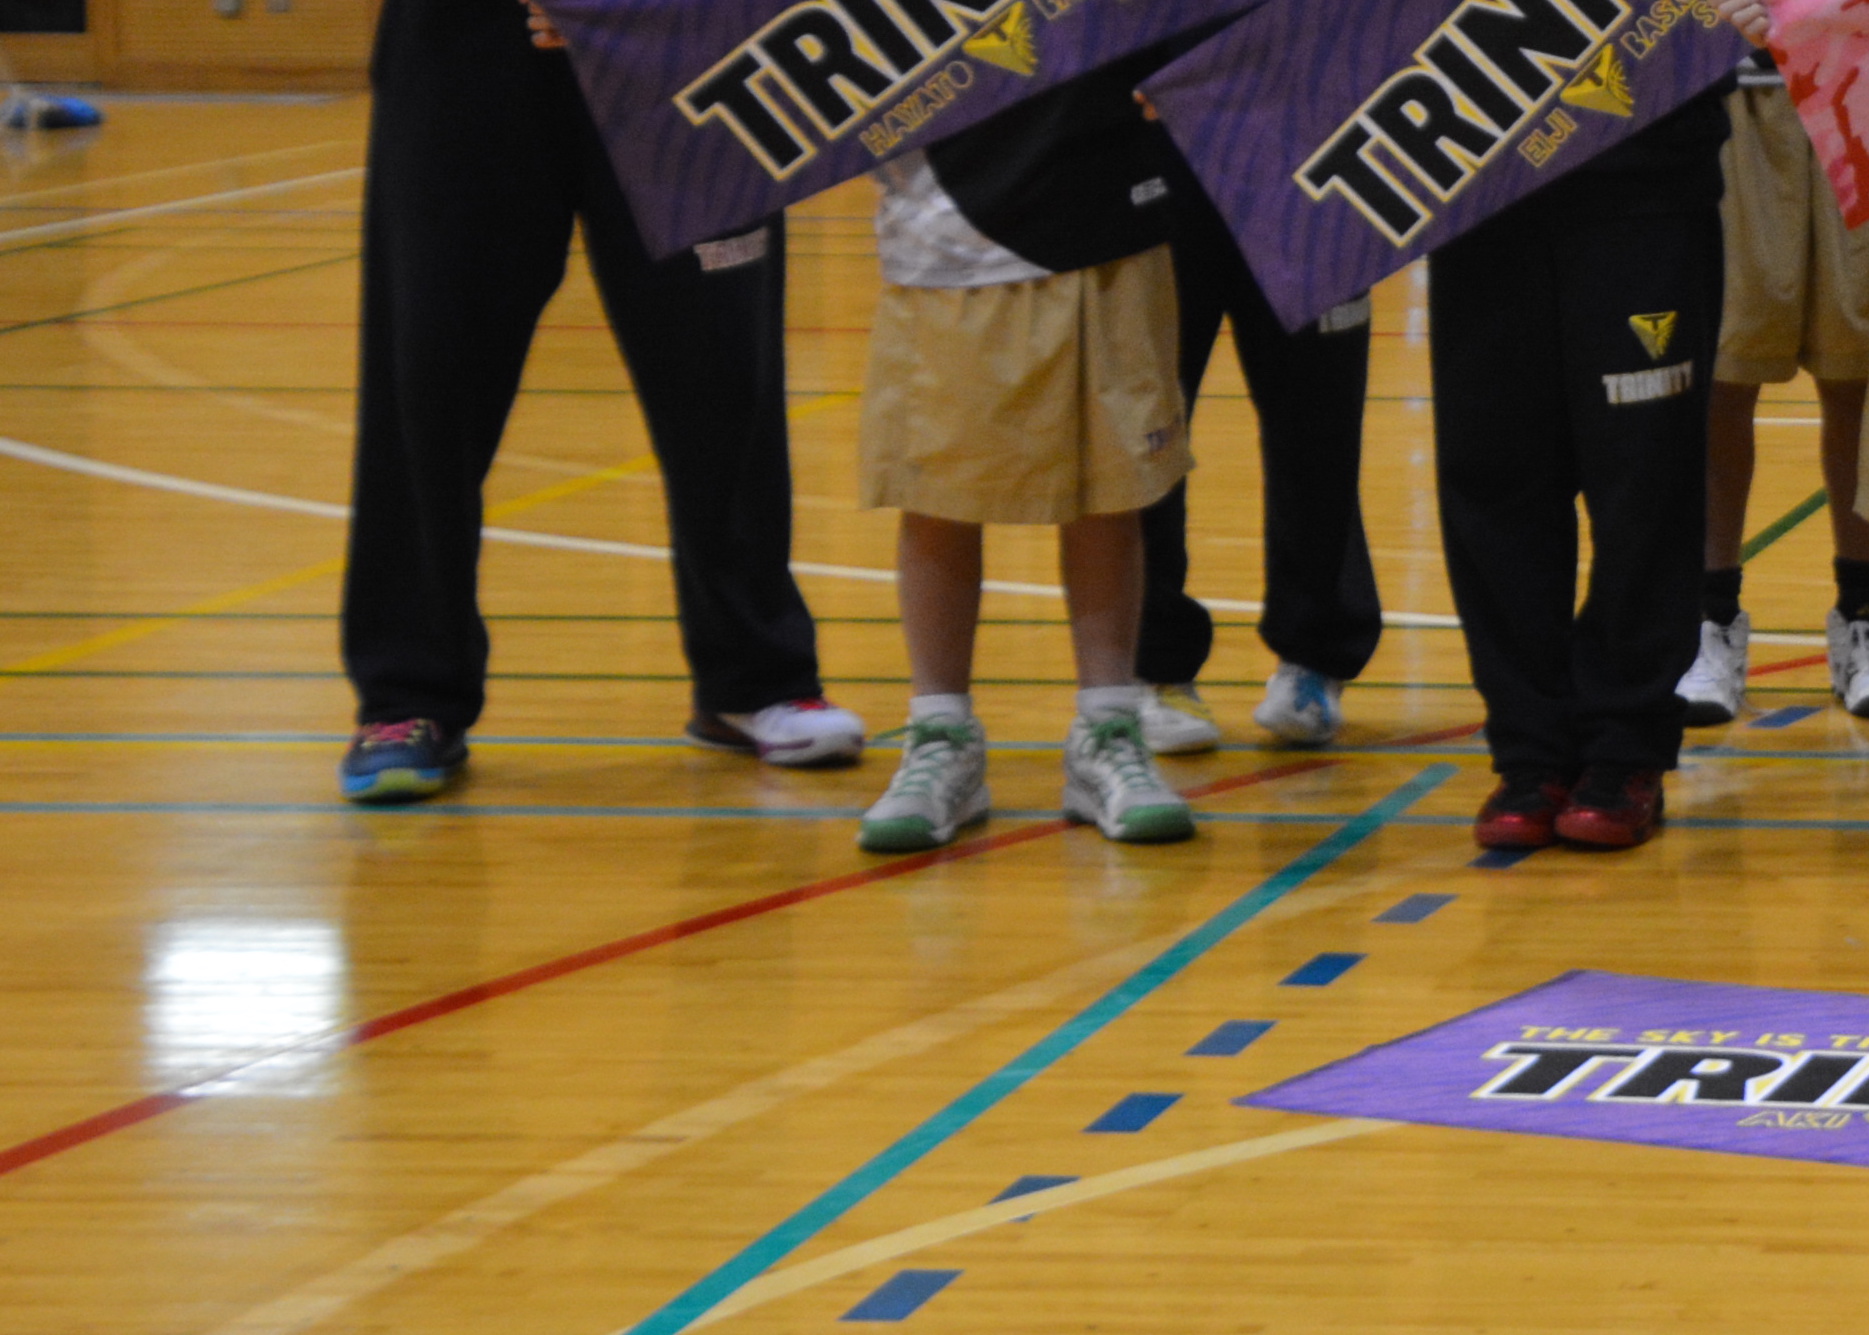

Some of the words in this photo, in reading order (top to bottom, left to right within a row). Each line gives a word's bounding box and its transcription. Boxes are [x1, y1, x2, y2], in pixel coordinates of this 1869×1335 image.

[858, 59, 975, 159] HAYATO
[1516, 107, 1580, 166] EIJI
[1520, 1024, 1619, 1043] THE
[1637, 1028, 1739, 1048] SKY
[1755, 1031, 1805, 1048] IS
